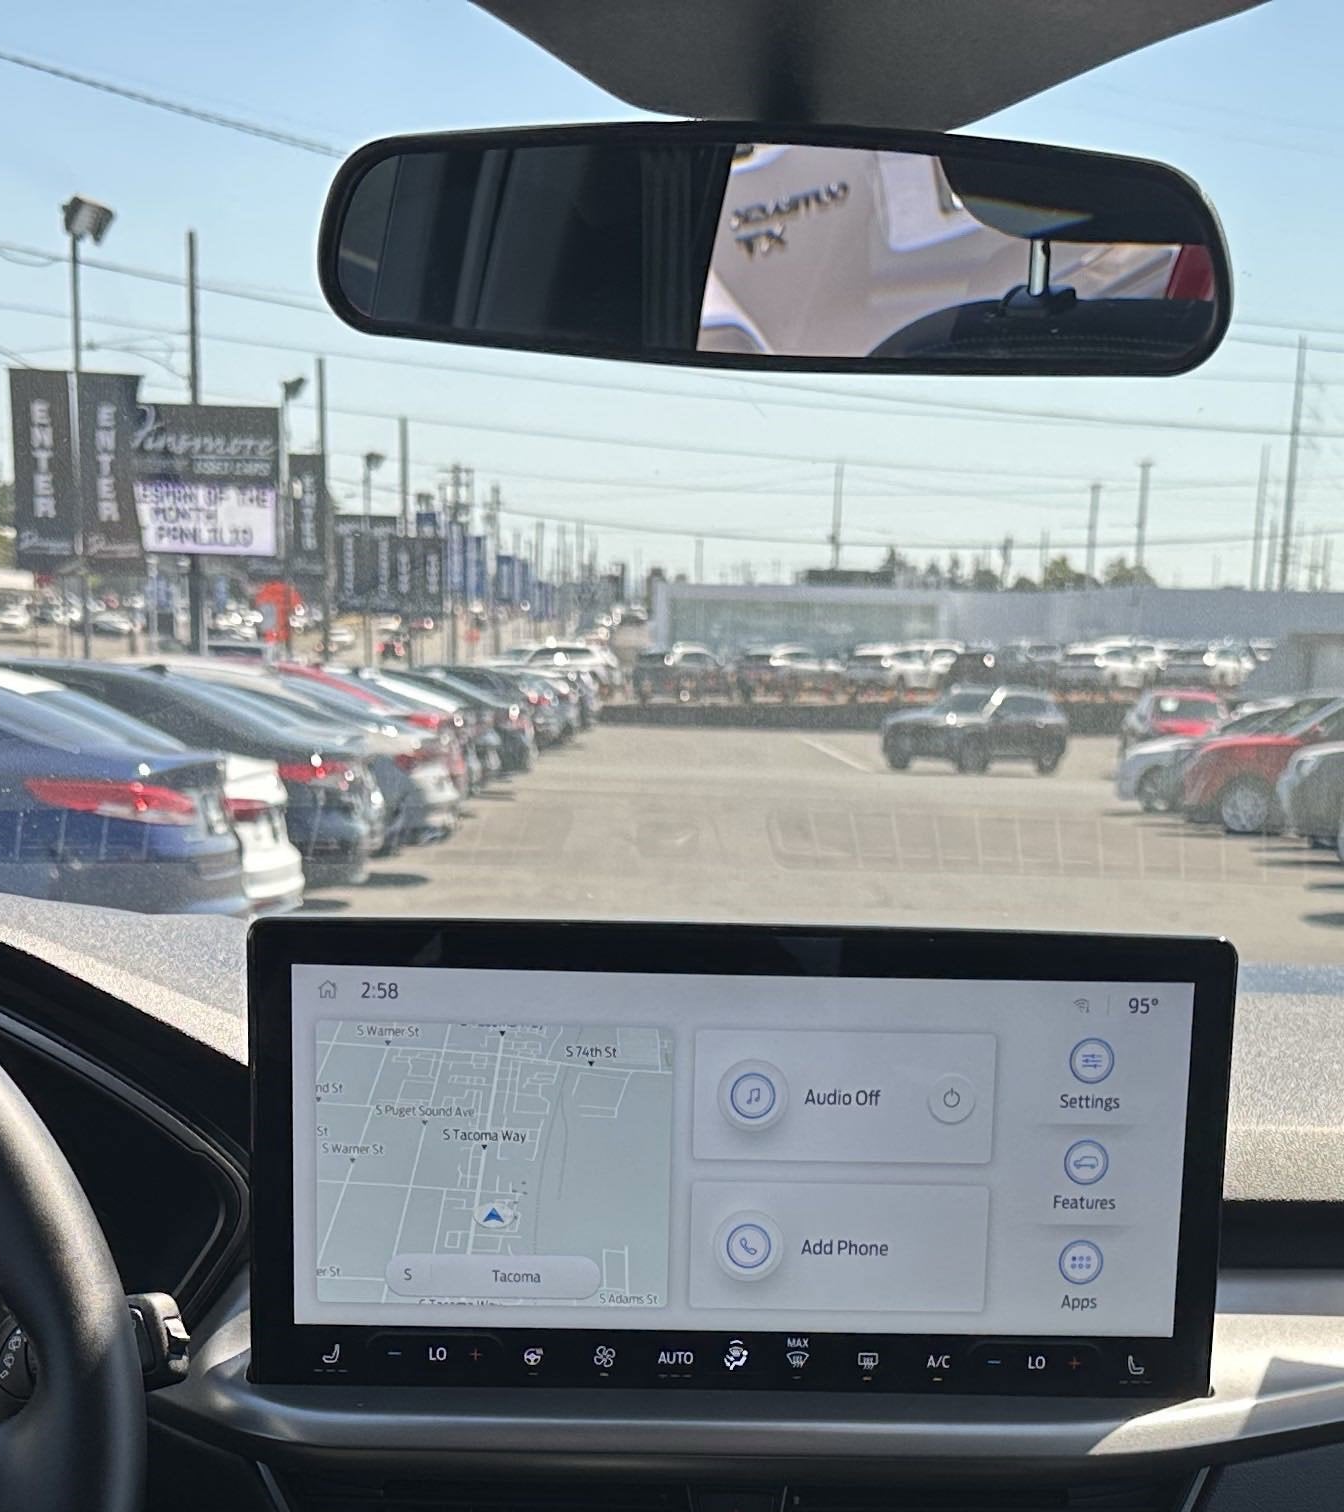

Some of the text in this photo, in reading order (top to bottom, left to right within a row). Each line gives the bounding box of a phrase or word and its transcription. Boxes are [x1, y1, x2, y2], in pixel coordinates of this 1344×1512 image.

[29, 398, 56, 518] ENTER
[95, 401, 120, 522] ENTER
[360, 981, 399, 1000] 2:58
[357, 1025, 364, 1037] S
[407, 1026, 419, 1038] St
[565, 1045, 617, 1059] S 74th St
[330, 1082, 344, 1093] St
[804, 1088, 881, 1106] Audio Off
[1059, 1093, 1120, 1112] Settings
[375, 1104, 475, 1119] S Puget Sound Ave
[316, 1125, 329, 1137] St
[442, 1128, 527, 1145] S Tacoma Way
[322, 1143, 384, 1156] S Warner St
[1053, 1194, 1116, 1210] Features
[801, 1239, 889, 1257] Add Phone
[330, 1266, 341, 1278] St
[403, 1268, 542, 1284] S Tacoma
[599, 1292, 659, 1305] S Adams St
[1061, 1295, 1097, 1312] Apps
[787, 1338, 809, 1348] MAX
[429, 1347, 447, 1362] LO
[658, 1351, 694, 1365] AUTO
[926, 1355, 951, 1369] A/C
[1028, 1356, 1046, 1370] LO
